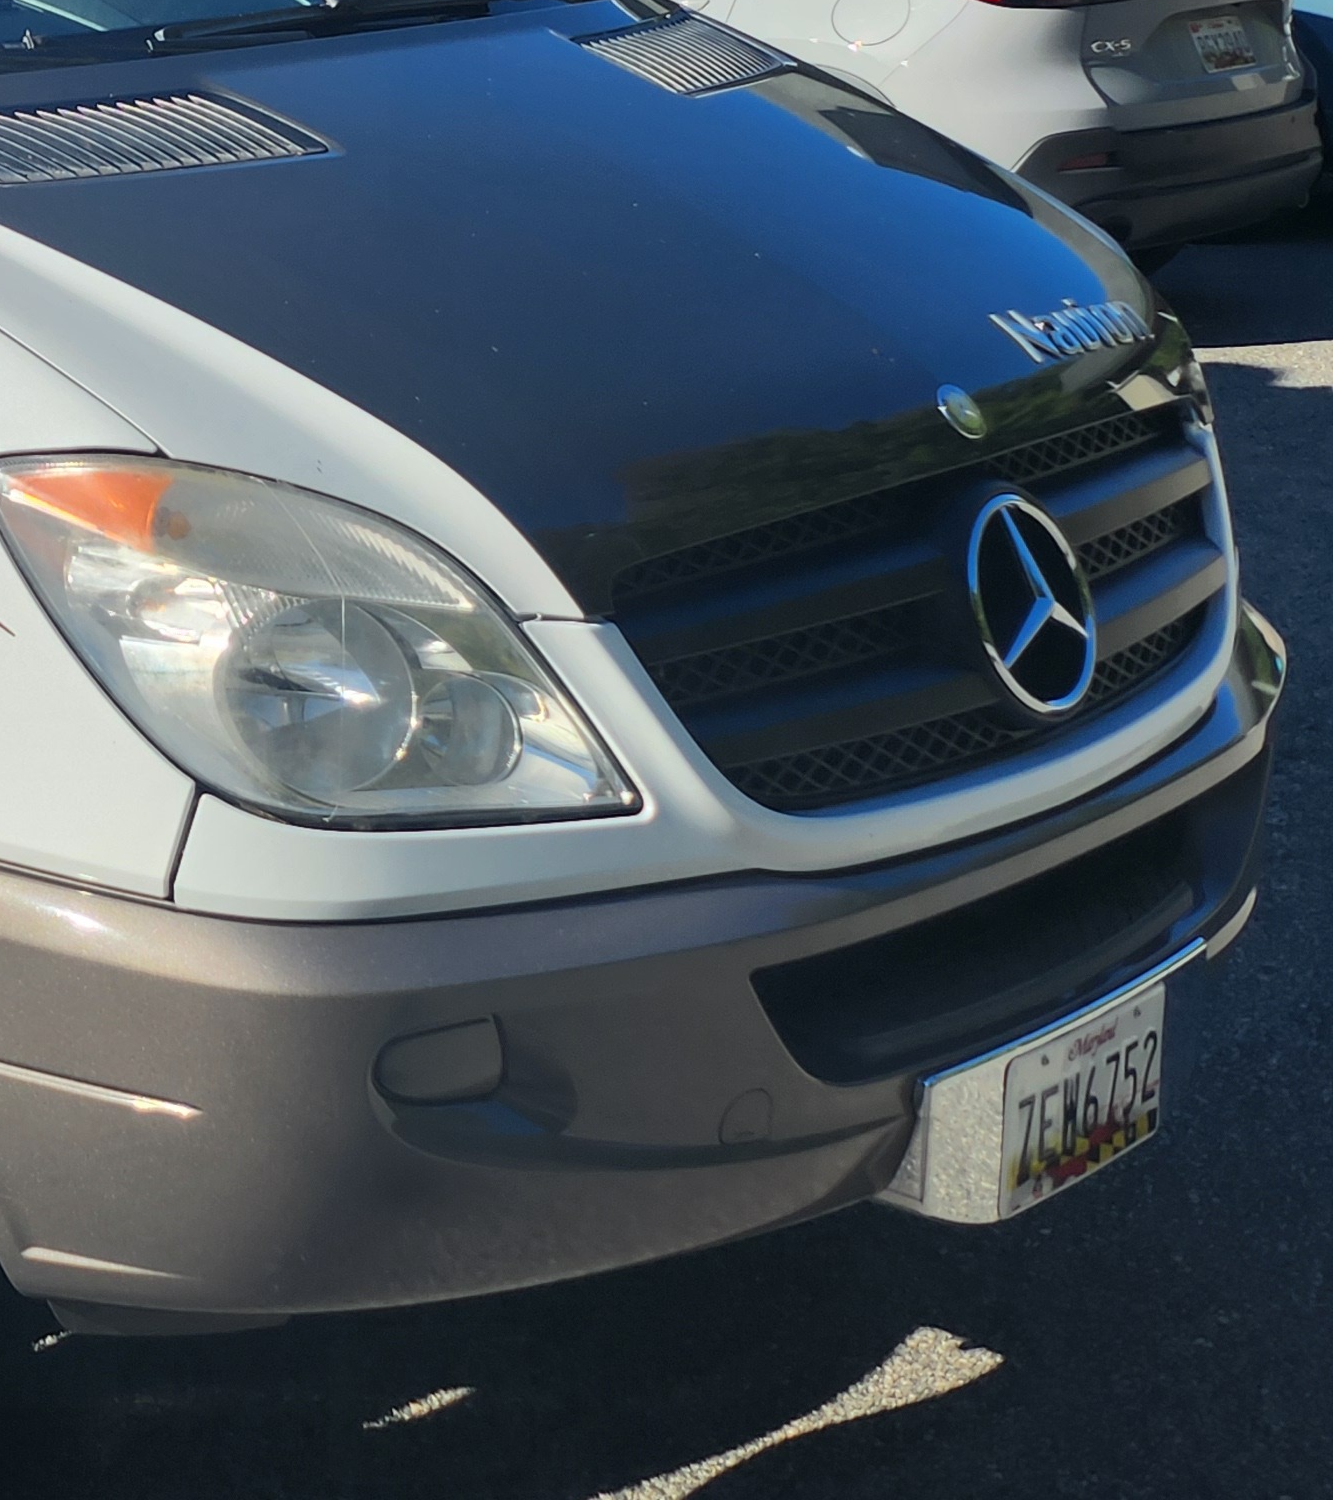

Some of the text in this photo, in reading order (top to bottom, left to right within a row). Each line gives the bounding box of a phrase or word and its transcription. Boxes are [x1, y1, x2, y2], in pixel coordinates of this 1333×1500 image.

[1090, 38, 1132, 53] CX-5
[1067, 1017, 1119, 1062] Maryland
[1016, 1030, 1158, 1187] 7EW6752
